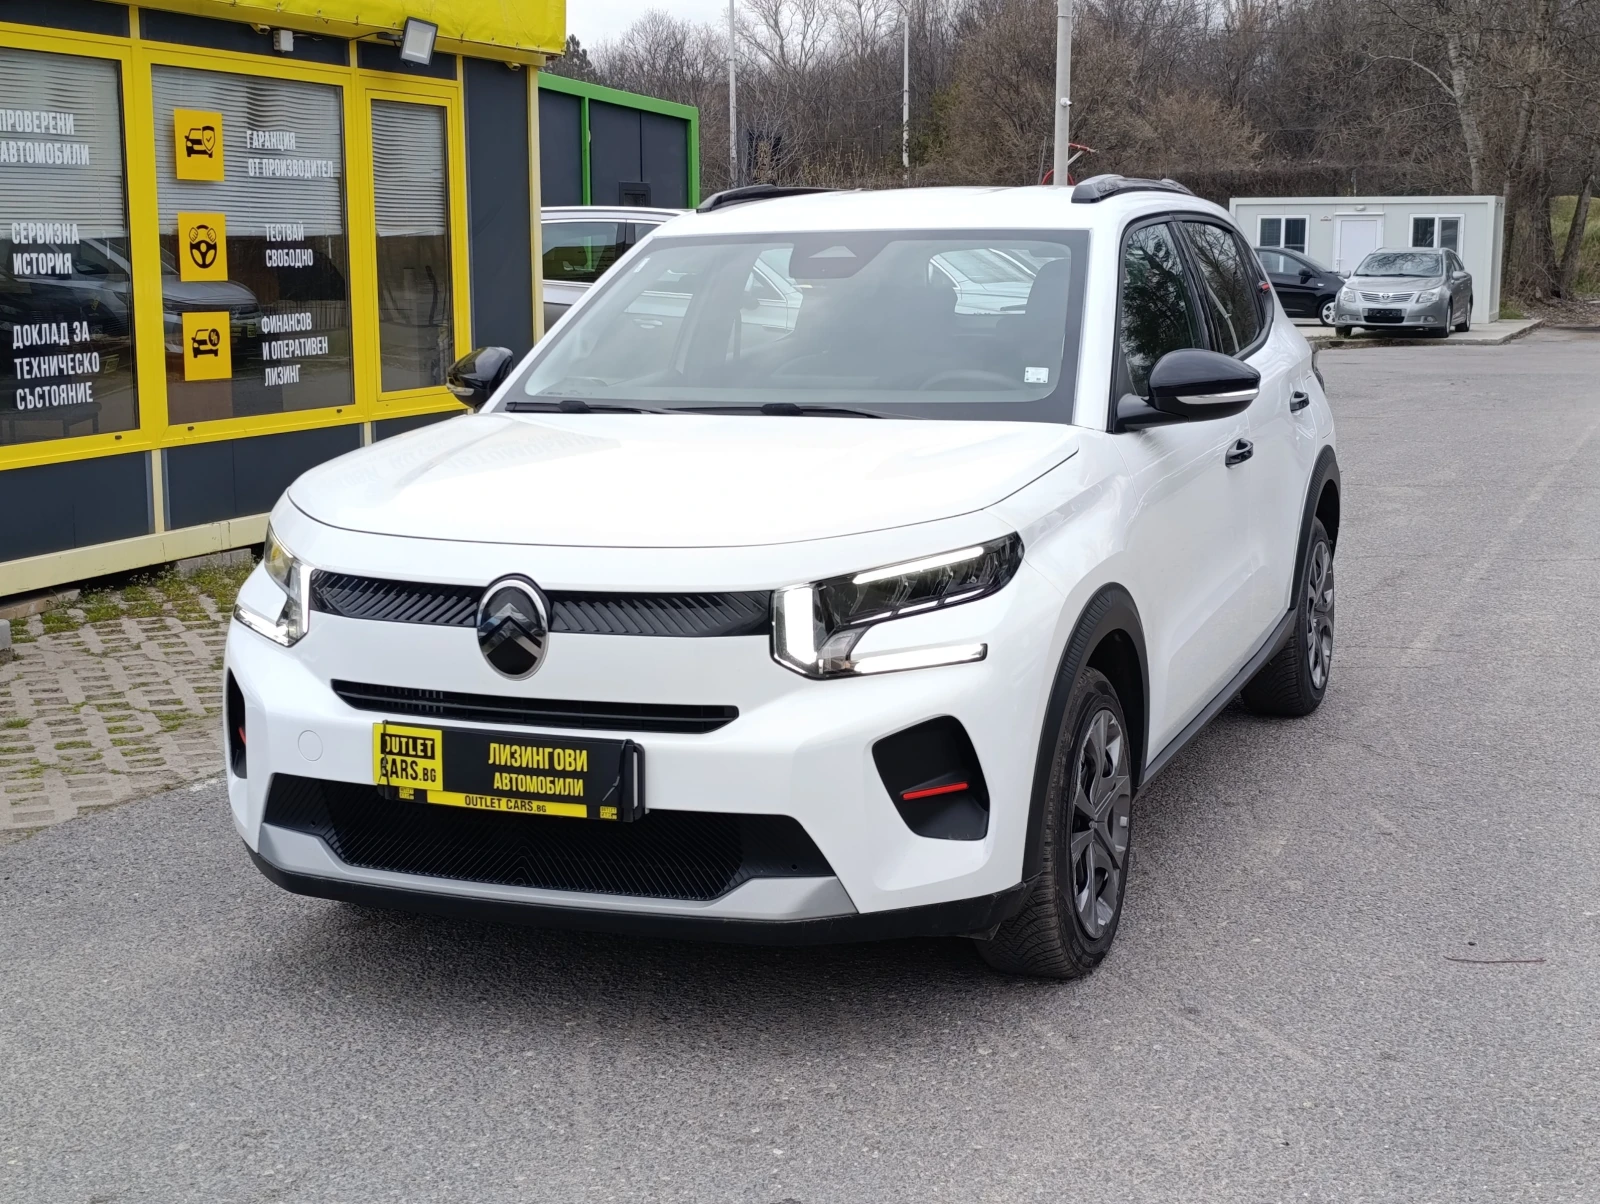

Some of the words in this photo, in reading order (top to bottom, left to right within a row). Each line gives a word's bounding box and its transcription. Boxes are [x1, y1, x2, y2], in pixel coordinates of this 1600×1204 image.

[0, 109, 75, 135] ПРОВЕРЕНИ
[246, 130, 296, 151] ГАРАНЦИЯ
[0, 141, 90, 165] АВТОМОБИЛИ
[248, 158, 260, 177] ОТ
[262, 159, 334, 179] ПРОИЗВОДИТЕЛ
[11, 222, 80, 245] СЕРВИЗНА
[265, 221, 305, 242] ТЕСТВАЙ
[13, 253, 73, 275] ИСТОРИЯ
[265, 249, 313, 269] СВОБОДНО
[261, 312, 313, 334] ФИНАНСОВ
[13, 322, 70, 349] ДОКЛАД
[73, 321, 90, 343] ЗА
[262, 341, 270, 360] И
[271, 336, 329, 360] ОПЕРАТИВЕН
[14, 352, 100, 380] ТЕХНИЧЕСКО
[264, 365, 301, 387] ЛИЗИНГ
[16, 382, 94, 410] СЪСТОЯНИЕ
[488, 742, 588, 772] ЛИЗИНГОВИ
[493, 772, 584, 797] АВТОМОБИЛИ
[464, 794, 503, 809] OUTLET
[506, 798, 547, 813] CARS.BG
